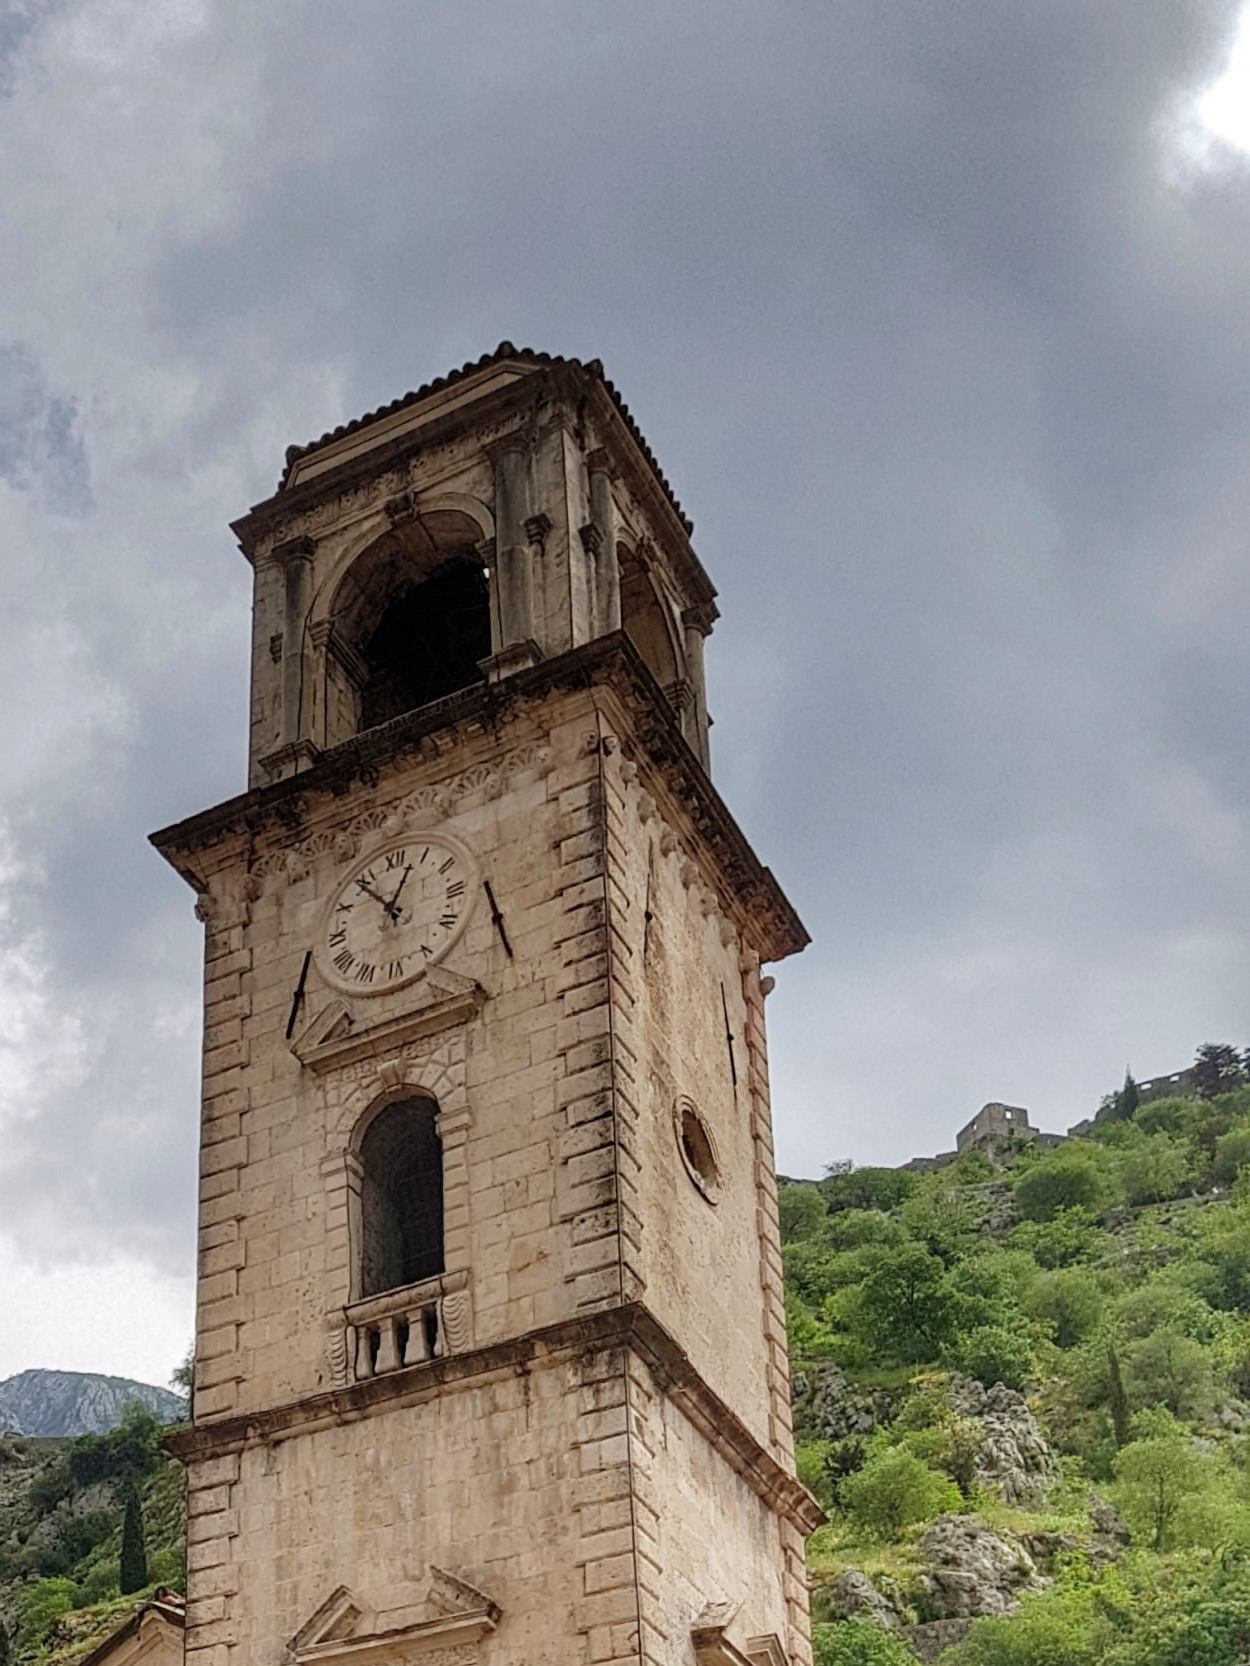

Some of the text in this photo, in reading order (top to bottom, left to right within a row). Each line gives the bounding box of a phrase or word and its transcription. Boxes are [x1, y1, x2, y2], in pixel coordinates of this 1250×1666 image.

[386, 850, 405, 872] XII
[420, 847, 430, 864] I
[438, 857, 455, 875] II
[446, 881, 464, 899] III
[336, 903, 354, 912] X
[329, 929, 346, 948] IX
[420, 944, 433, 958] V
[388, 962, 403, 980] VI
